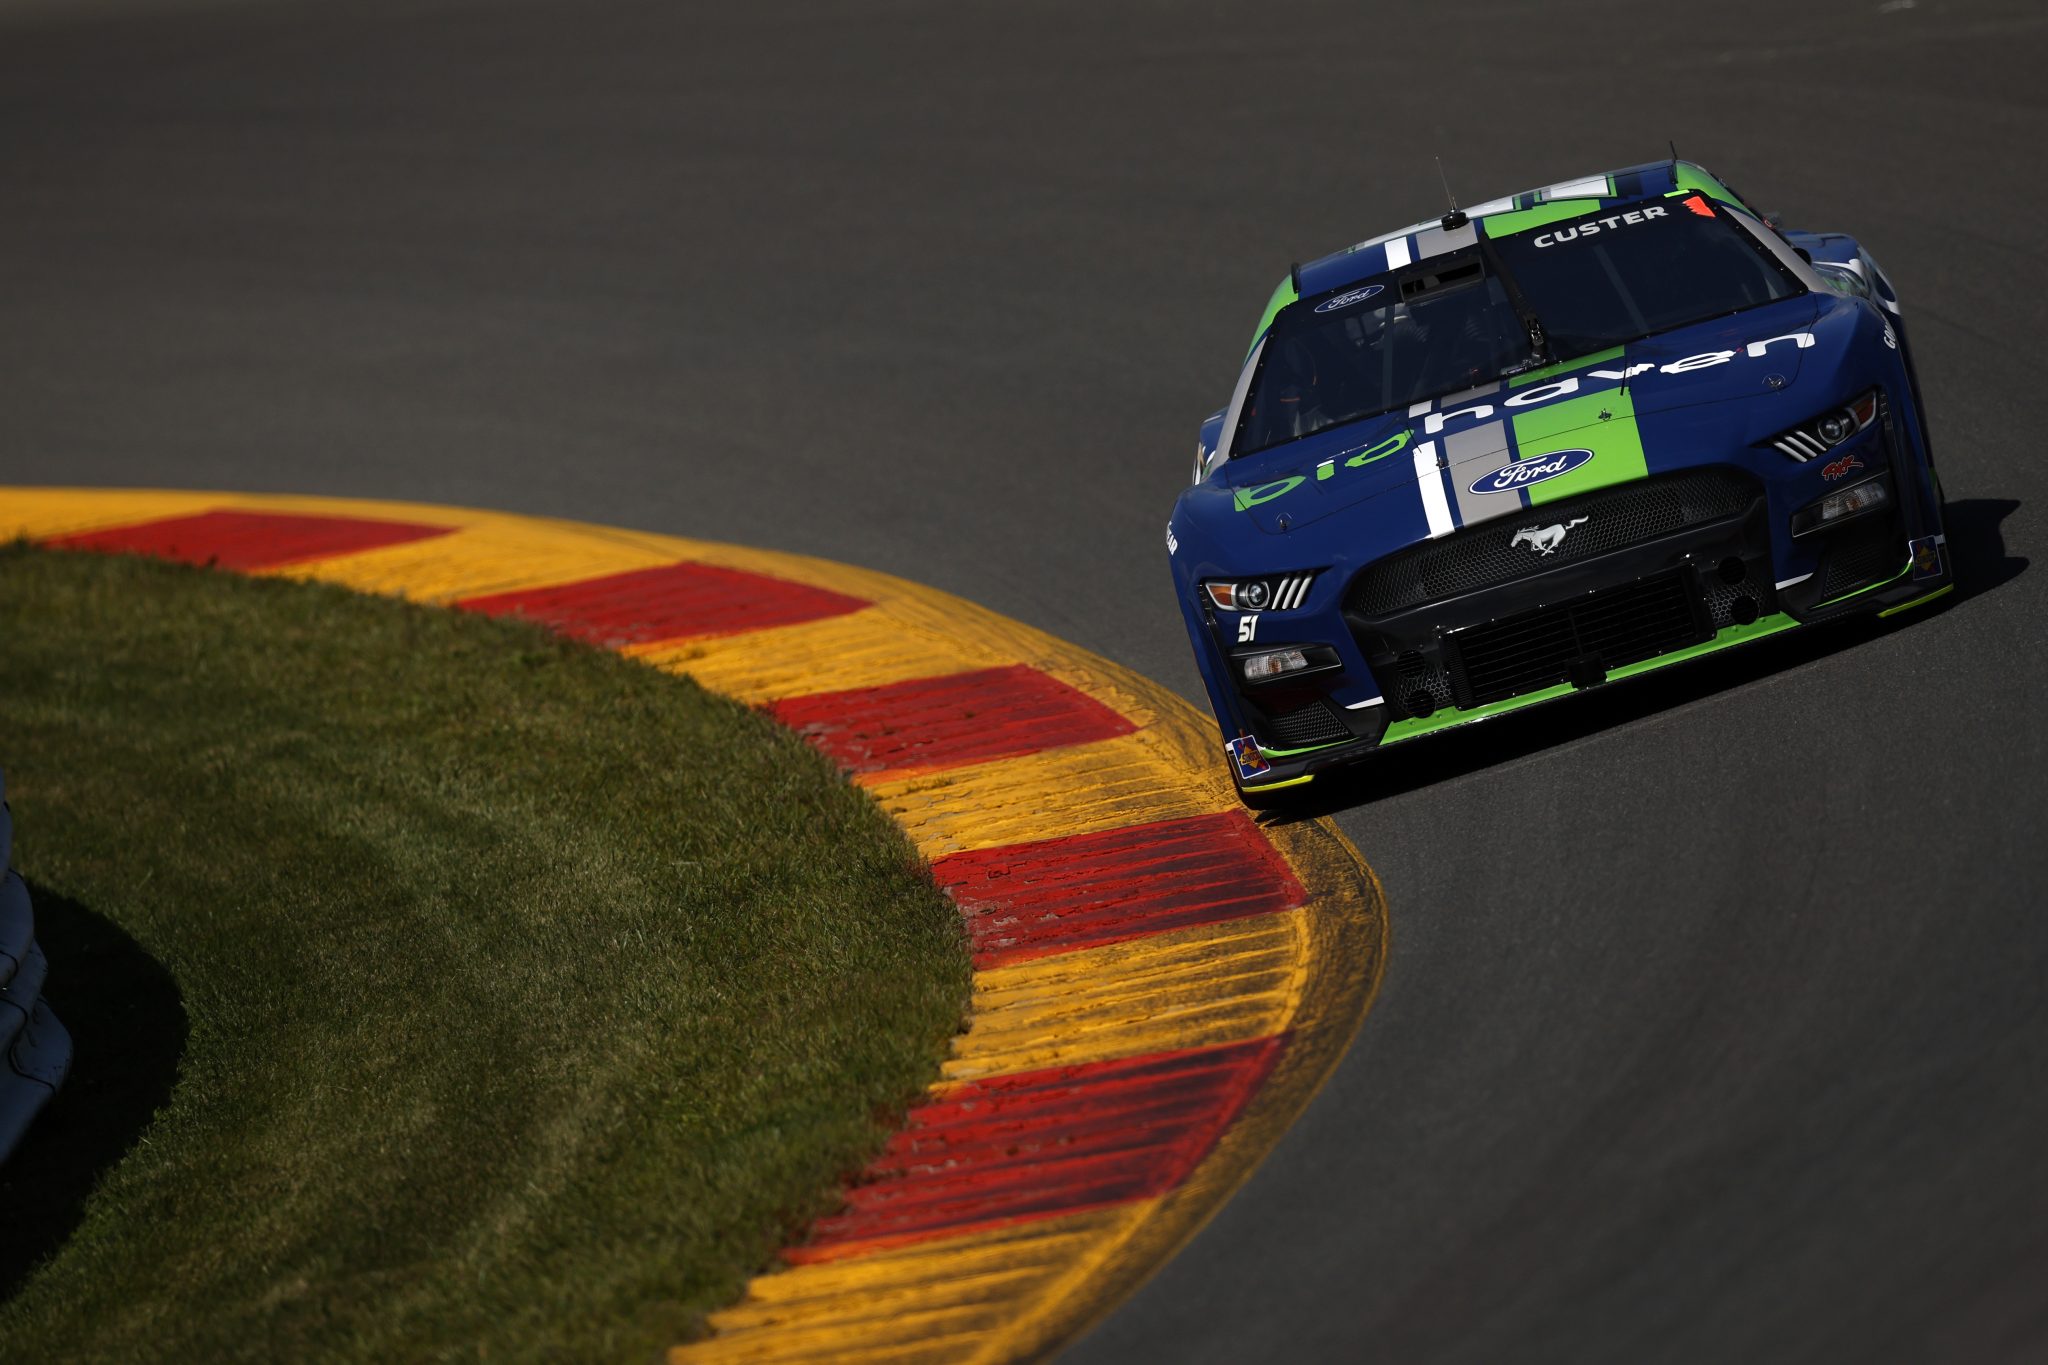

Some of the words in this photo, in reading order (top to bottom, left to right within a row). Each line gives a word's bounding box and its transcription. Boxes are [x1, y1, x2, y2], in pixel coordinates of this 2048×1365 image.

[1534, 206, 1670, 249] CUSTER
[1493, 455, 1568, 489] Ford
[1237, 614, 1260, 643] 51
